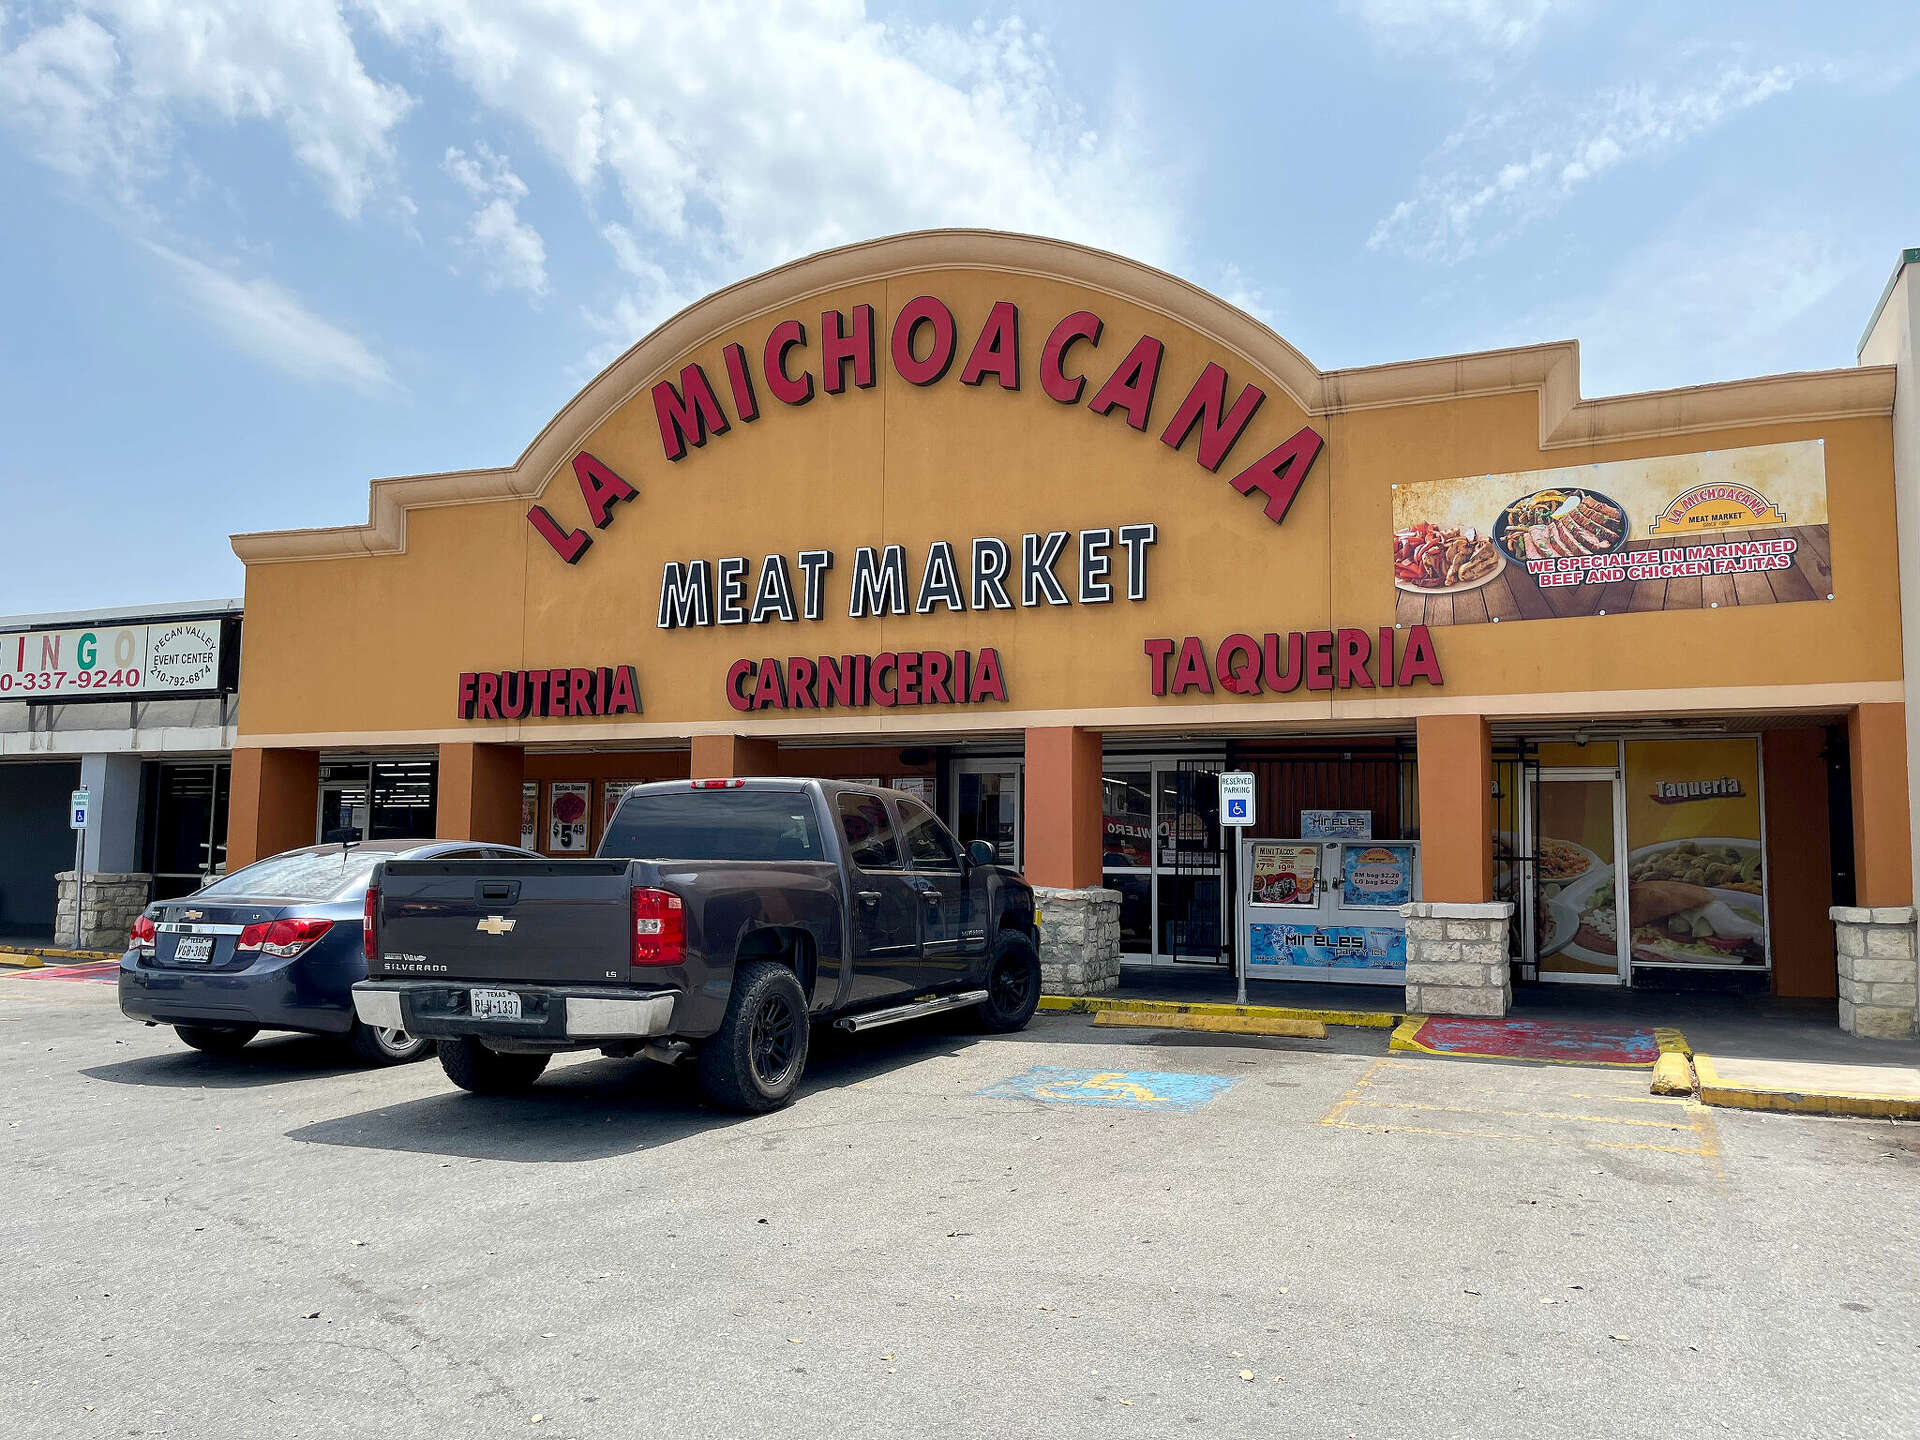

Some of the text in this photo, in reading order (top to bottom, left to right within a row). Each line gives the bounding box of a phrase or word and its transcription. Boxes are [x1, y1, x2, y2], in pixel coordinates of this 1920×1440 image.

[527, 296, 1324, 565] LA MICHOACANA
[1668, 487, 1767, 524] LA MICHOACANA
[1688, 515, 1709, 523] MEAT
[1711, 512, 1743, 521] MARKET
[1528, 539, 1797, 574] WE SPECIALIZE IN MARINATED
[1539, 555, 1791, 587] BEEF AND CHICKEN FAJITAS
[656, 523, 1158, 630] MEAT MARKET
[0, 630, 136, 672] INGO
[154, 626, 217, 653] PECAN VALLEY
[153, 652, 214, 666] EVENT CENTER
[1144, 625, 1444, 696] TAQUERIA
[0, 669, 140, 691] 0-337-9240
[150, 664, 212, 687] 210-792-6874
[726, 648, 1009, 712] CARNICERIA
[458, 665, 643, 720] FRUTERIA
[1221, 777, 1252, 785] RESERVED
[1223, 786, 1251, 794] PARKING
[1655, 778, 1739, 798] Taqueria
[384, 963, 448, 972] SILVERADO
